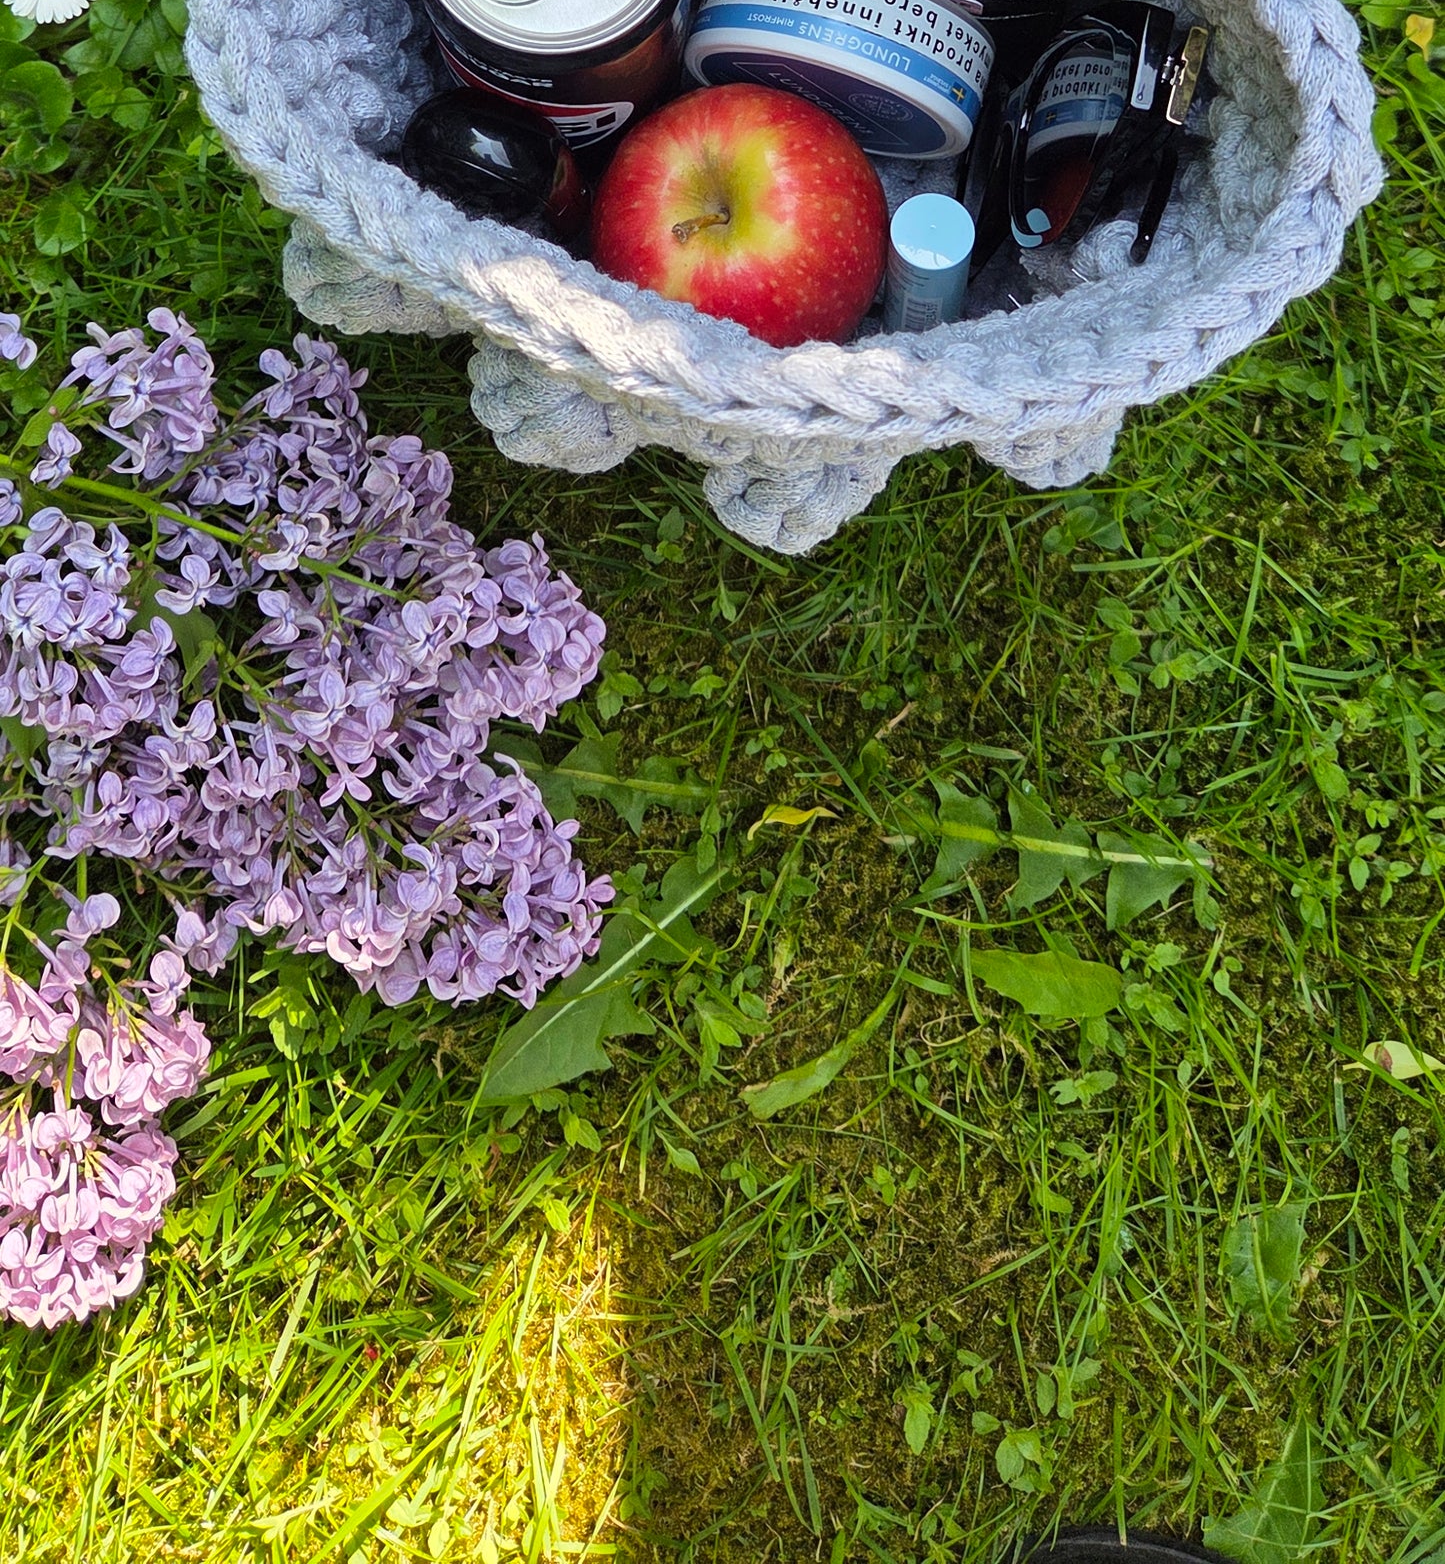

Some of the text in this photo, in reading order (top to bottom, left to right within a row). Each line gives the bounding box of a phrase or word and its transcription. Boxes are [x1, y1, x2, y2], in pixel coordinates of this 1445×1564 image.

[747, 12, 911, 72] LUNDGRENS RIMFROST
[894, 19, 973, 74] produkt
